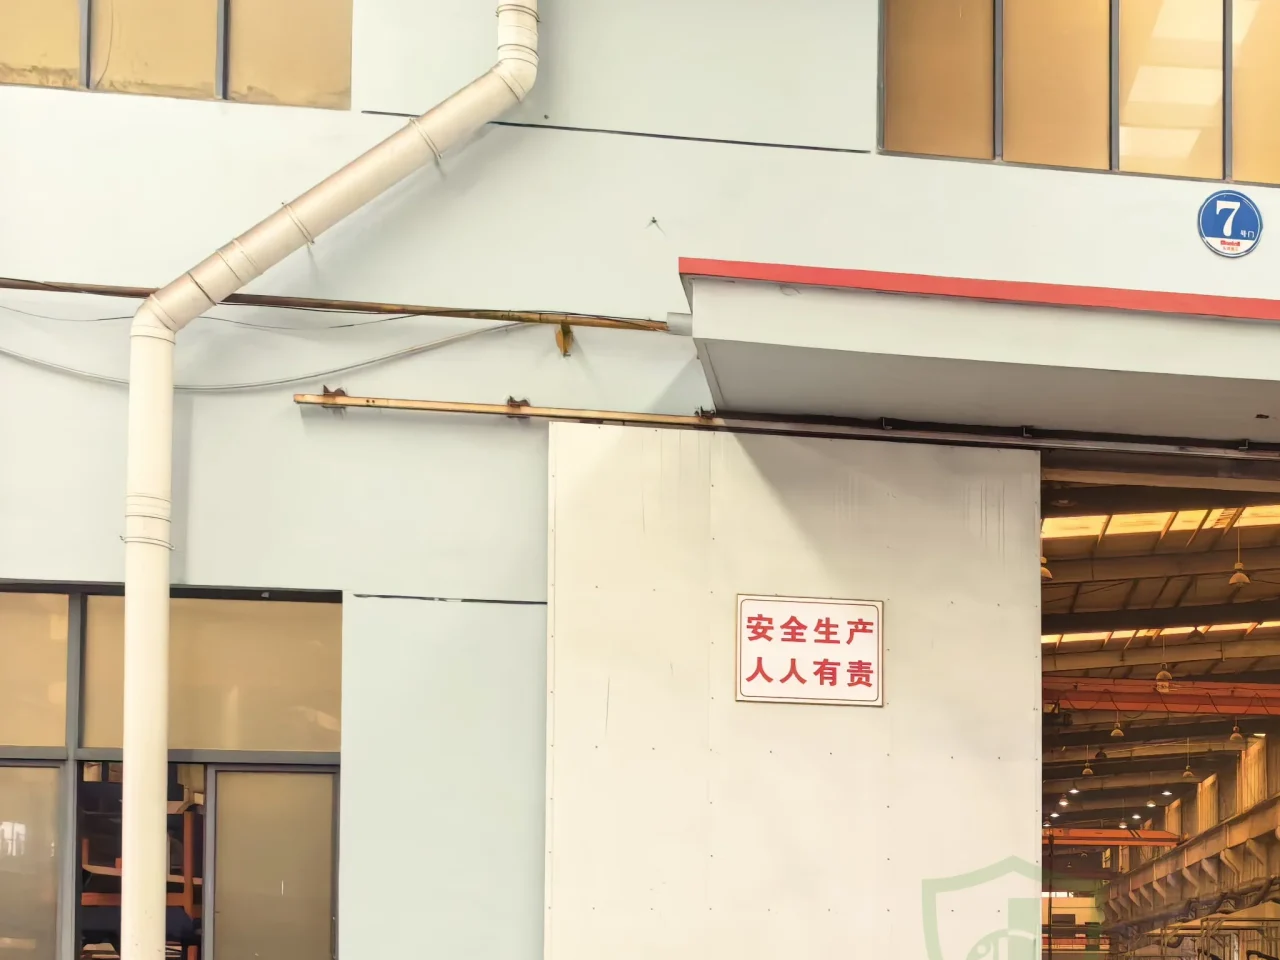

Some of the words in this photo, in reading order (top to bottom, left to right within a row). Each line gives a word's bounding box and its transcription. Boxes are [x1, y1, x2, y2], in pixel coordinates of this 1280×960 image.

[1215, 200, 1240, 237] 7
[746, 613, 874, 645] 安全生产
[745, 656, 874, 688] 人人有责
